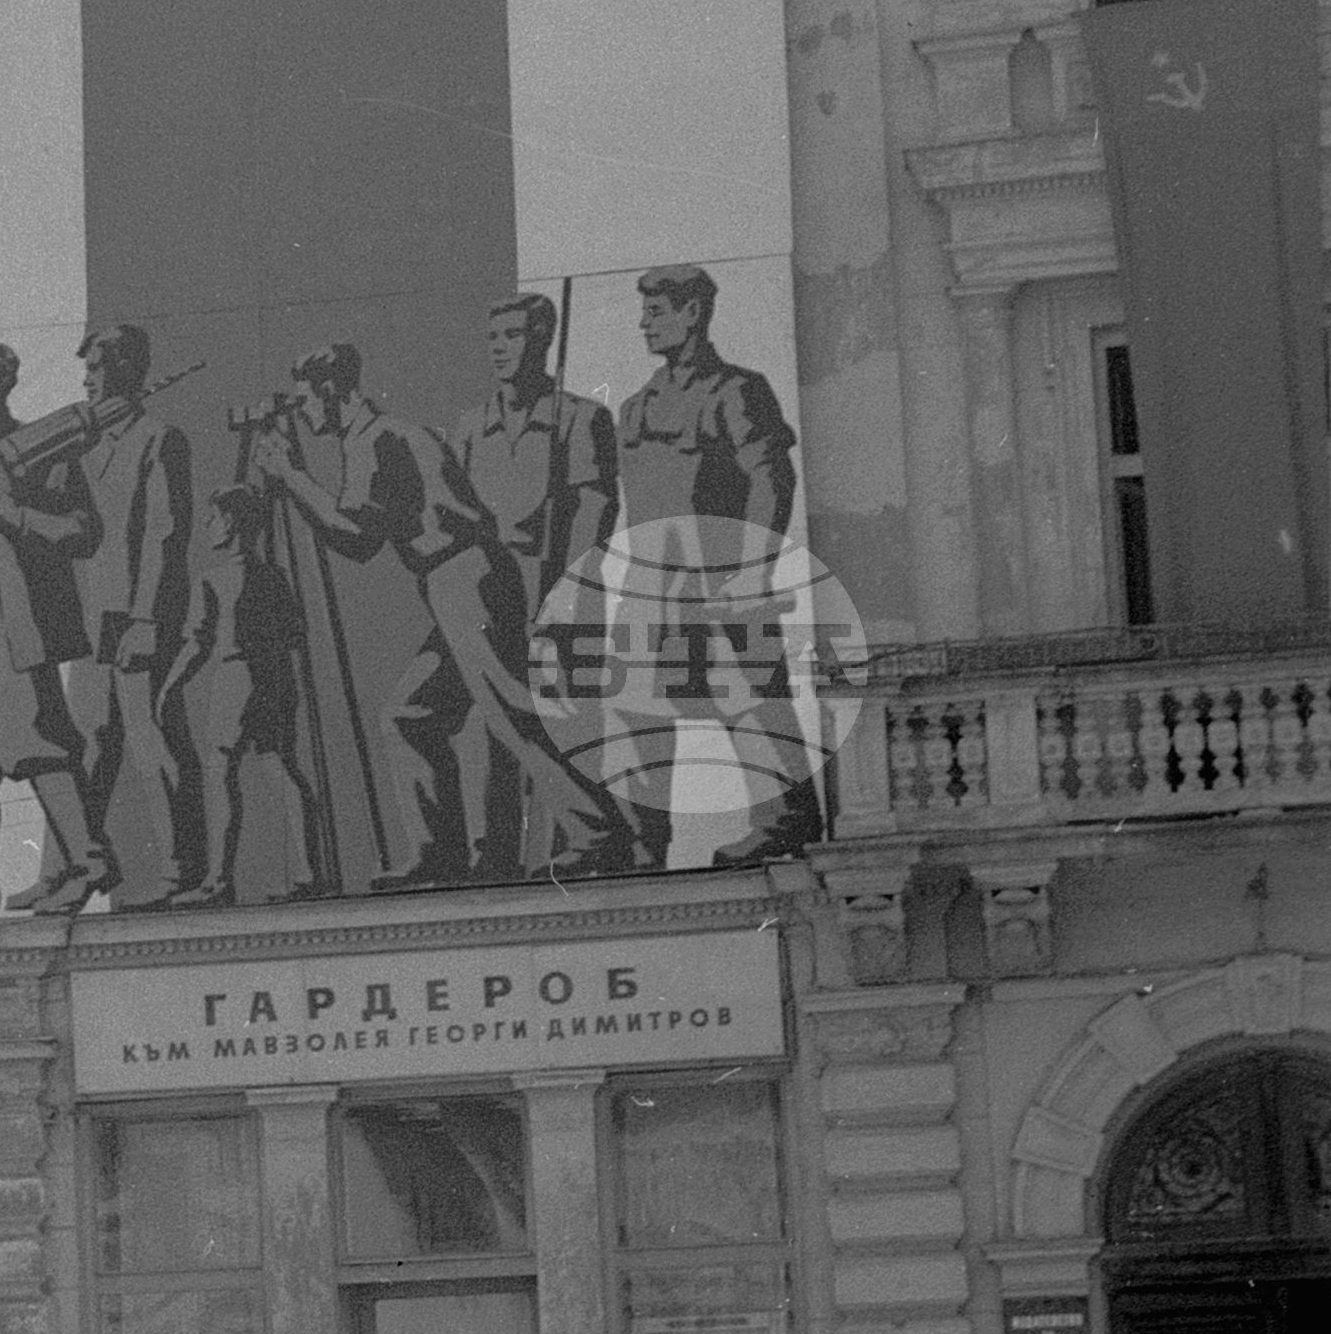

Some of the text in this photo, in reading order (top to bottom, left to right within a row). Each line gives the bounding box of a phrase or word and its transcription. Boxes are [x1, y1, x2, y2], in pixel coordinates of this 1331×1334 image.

[203, 967, 641, 1027] ГАРДЕРОБ
[122, 1004, 735, 1064] КЪМ МАВЗОЛЕЯ ГЕОРГИ ДИМИТРОВ
